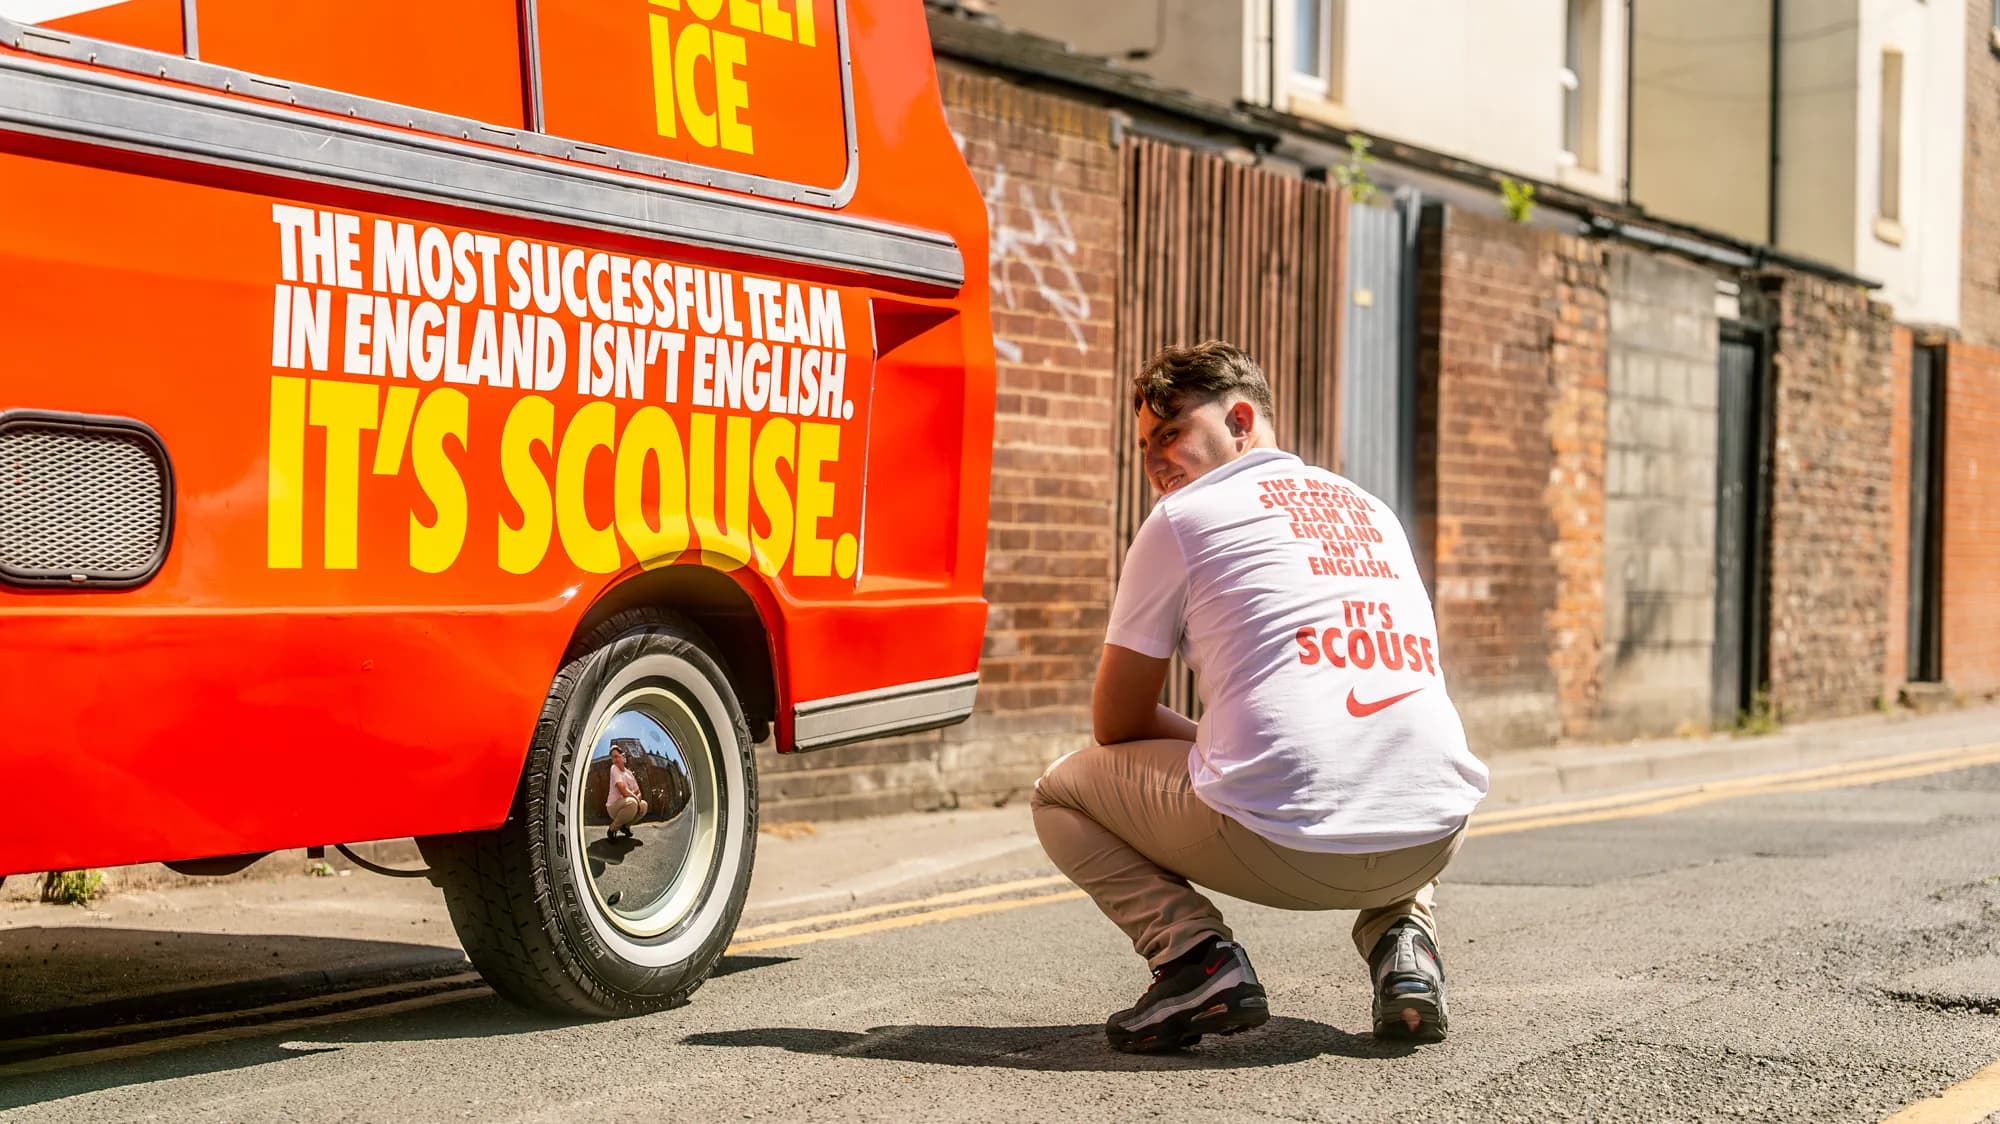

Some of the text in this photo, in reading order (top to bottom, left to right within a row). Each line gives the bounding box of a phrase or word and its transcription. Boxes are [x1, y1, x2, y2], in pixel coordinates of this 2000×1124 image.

[648, 13, 754, 155] ICE
[272, 204, 846, 350] THE MOST SUCCESSFUL TEAM
[271, 284, 855, 420] IN ENGLAND ISN'T ENGLISH.
[267, 376, 858, 579] IT'S SCOUSE.
[1257, 479, 1299, 493] THE
[1259, 491, 1377, 512] SUCCESSFUL
[1284, 507, 1372, 526] TEAM IN
[1289, 522, 1384, 543] ENGLAND
[1321, 540, 1373, 559] ISN'T
[1307, 556, 1400, 580] ENGLISH.
[1342, 600, 1394, 630] IT'S
[556, 720, 579, 859] STONE
